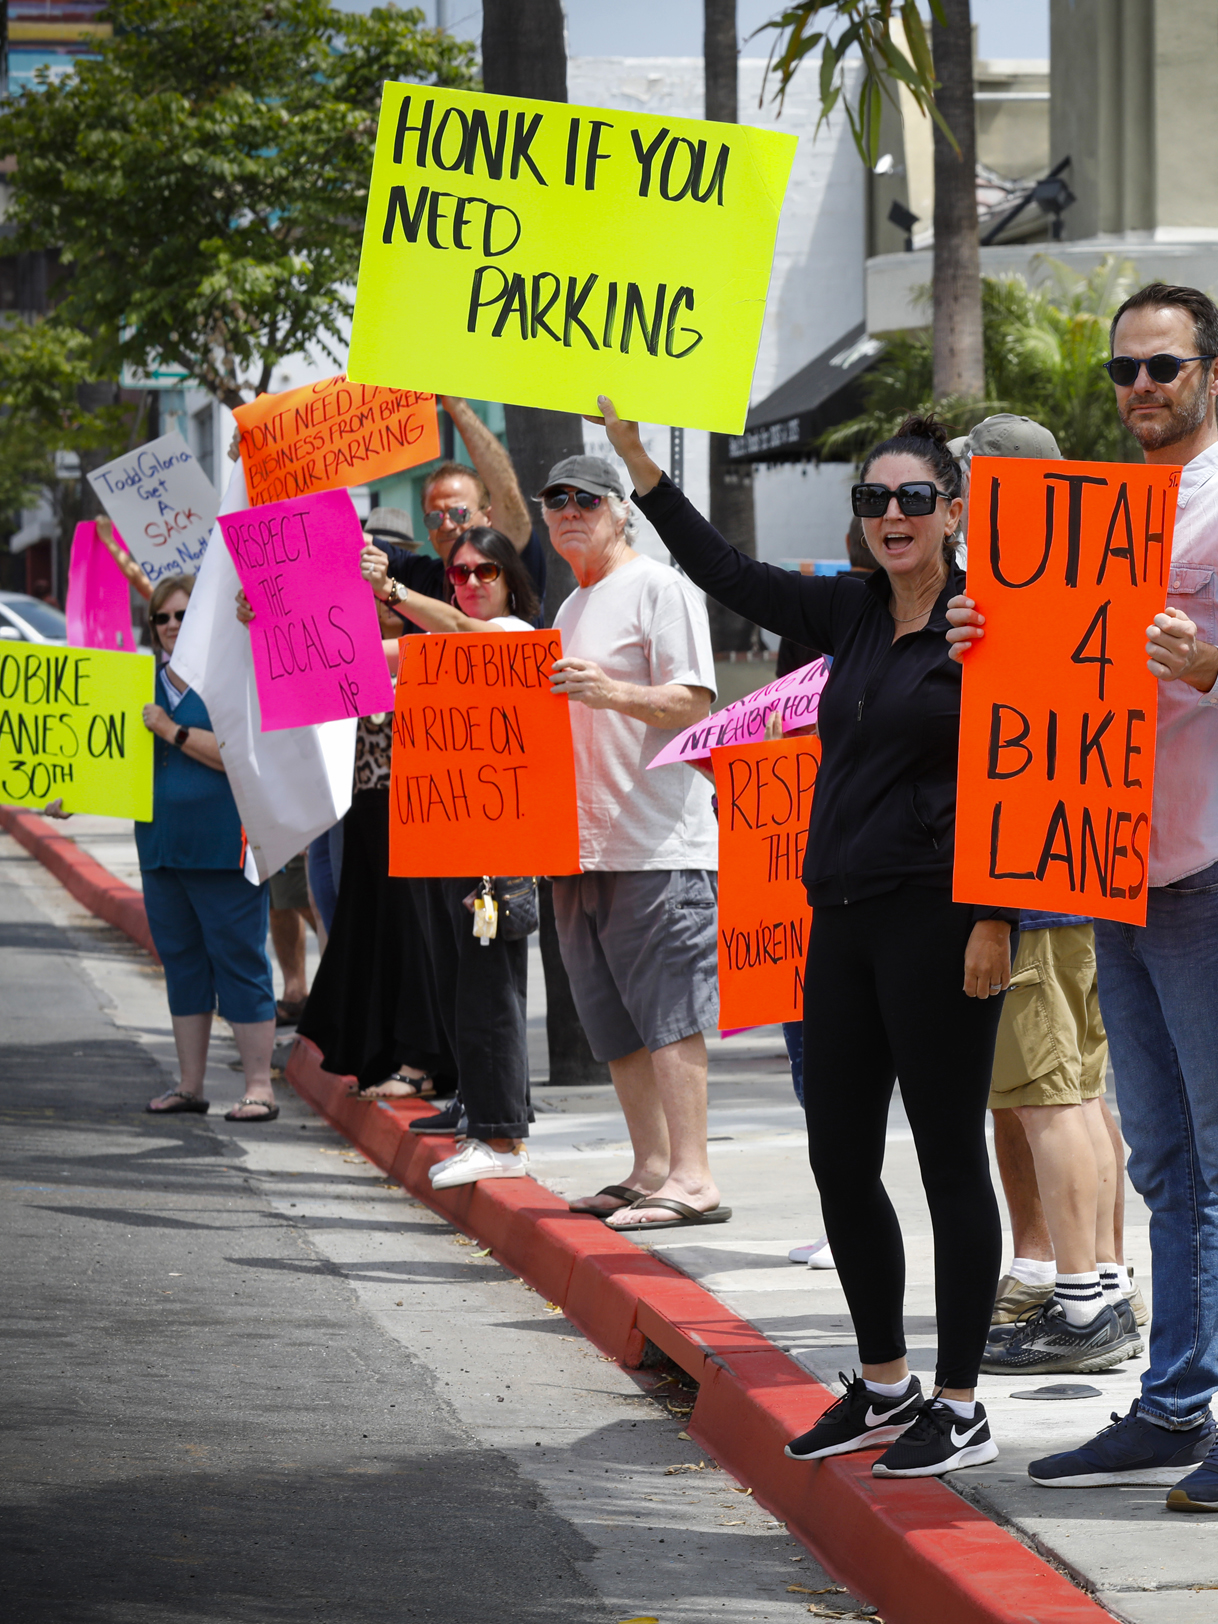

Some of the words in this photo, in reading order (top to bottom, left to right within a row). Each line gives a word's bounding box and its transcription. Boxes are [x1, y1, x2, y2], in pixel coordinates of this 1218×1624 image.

[393, 96, 548, 187] HONK
[565, 117, 614, 190] IF
[631, 127, 730, 207] YOU
[382, 185, 521, 257] NEED
[467, 266, 703, 359] PARKING
[295, 389, 352, 435] NEED
[94, 467, 142, 493] Todd
[137, 451, 192, 479] Gloria
[249, 431, 325, 489] BUSINESS
[330, 407, 375, 444] FROM
[284, 458, 323, 500] OUR
[323, 413, 424, 480] PARKING
[137, 479, 168, 501] Get
[157, 500, 175, 516] A
[144, 508, 202, 547] SACK
[227, 512, 311, 571] RESPECT
[990, 472, 1167, 588] UTAH
[141, 559, 184, 581] Bring
[259, 574, 292, 618] THE
[263, 605, 356, 680] LOCALS
[418, 639, 448, 686] 1%
[455, 644, 478, 684] OF
[1071, 599, 1114, 701] 4
[24, 654, 91, 706] BIKE
[88, 711, 125, 759] ON
[423, 706, 484, 752] RIDE
[490, 705, 526, 756] ON
[987, 702, 1146, 789] BIKE
[2, 760, 73, 800] 30TH
[396, 768, 471, 825] UTAH
[478, 764, 528, 820] ST.
[762, 829, 808, 883] THE
[989, 799, 1149, 900] LANES
